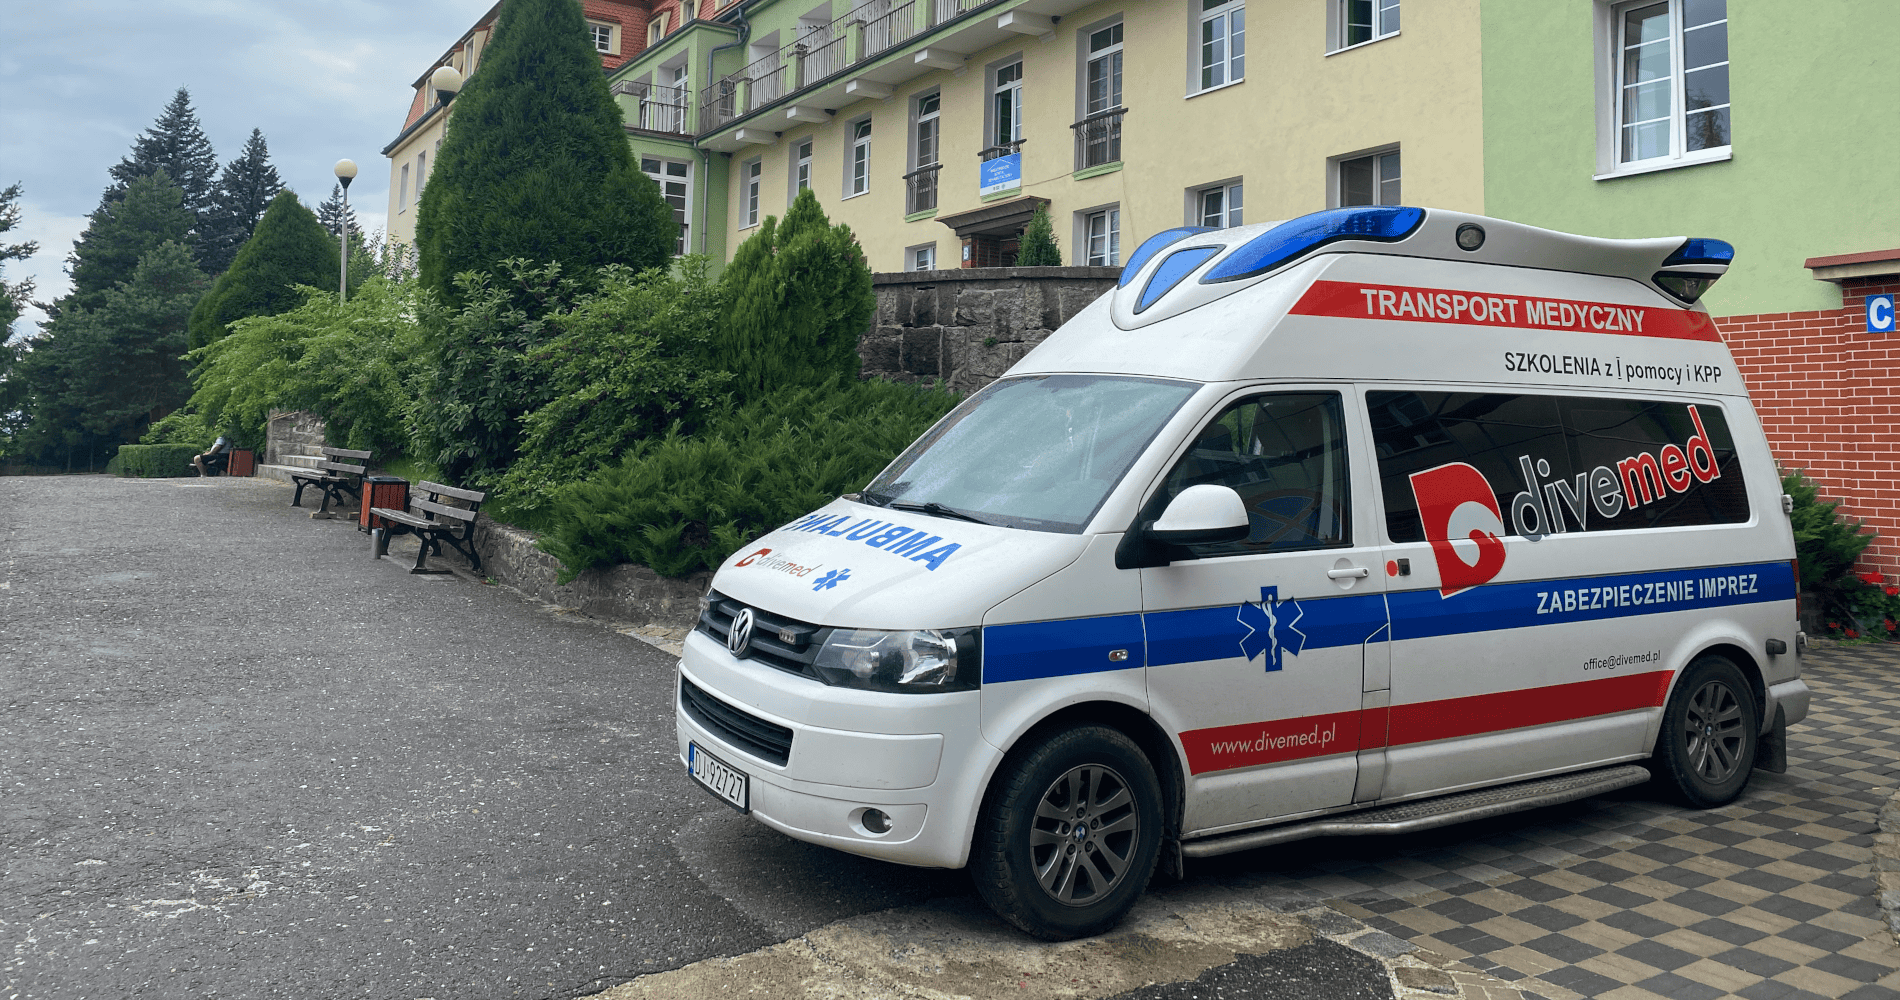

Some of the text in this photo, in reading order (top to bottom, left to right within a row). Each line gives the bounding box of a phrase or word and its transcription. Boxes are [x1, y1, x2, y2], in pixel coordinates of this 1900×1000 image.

[1360, 288, 1645, 333] TRANSPORT MEDYCZNY
[1869, 297, 1892, 329] C
[1504, 351, 1601, 376] SZKOLENIA
[1604, 362, 1613, 377] z
[1625, 363, 1682, 385] pomocy
[1686, 363, 1690, 382] i
[1693, 364, 1721, 383] KPP
[1511, 404, 1721, 543] divemed
[756, 553, 823, 577] divemed
[1536, 573, 1758, 614] ZABEZPIECZENIE IMPREZ
[1583, 649, 1661, 670] office@divemed.pl
[1211, 722, 1336, 755] www.divemed.pl
[709, 761, 743, 802] 92727
